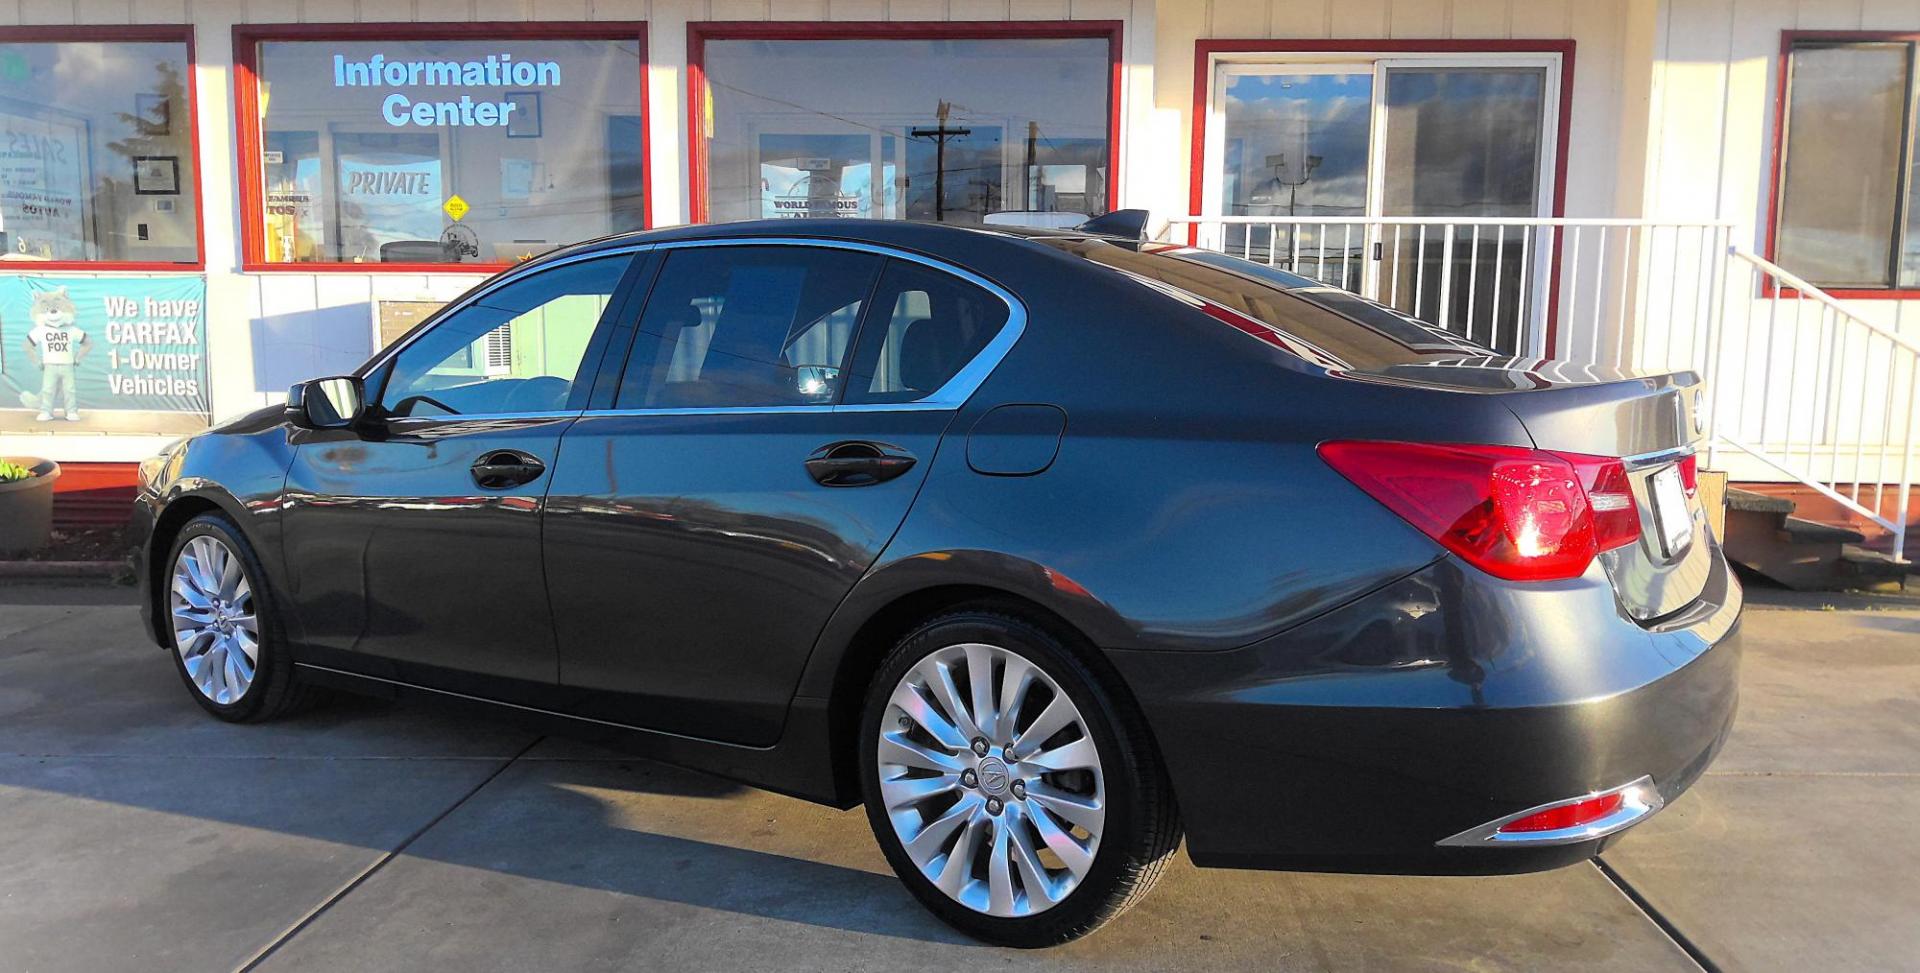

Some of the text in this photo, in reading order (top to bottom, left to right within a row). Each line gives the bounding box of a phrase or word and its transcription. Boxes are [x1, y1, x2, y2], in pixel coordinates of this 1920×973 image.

[334, 54, 561, 87] Information
[382, 93, 516, 127] Center
[348, 166, 431, 196] PRIVATE
[774, 201, 811, 209] WORLD
[104, 296, 199, 317] We have
[45, 332, 68, 342] CAR
[105, 321, 199, 345] CARFAX
[48, 342, 69, 353] FOX
[107, 349, 201, 371] 1-Owner
[108, 374, 199, 397] Vehicles
